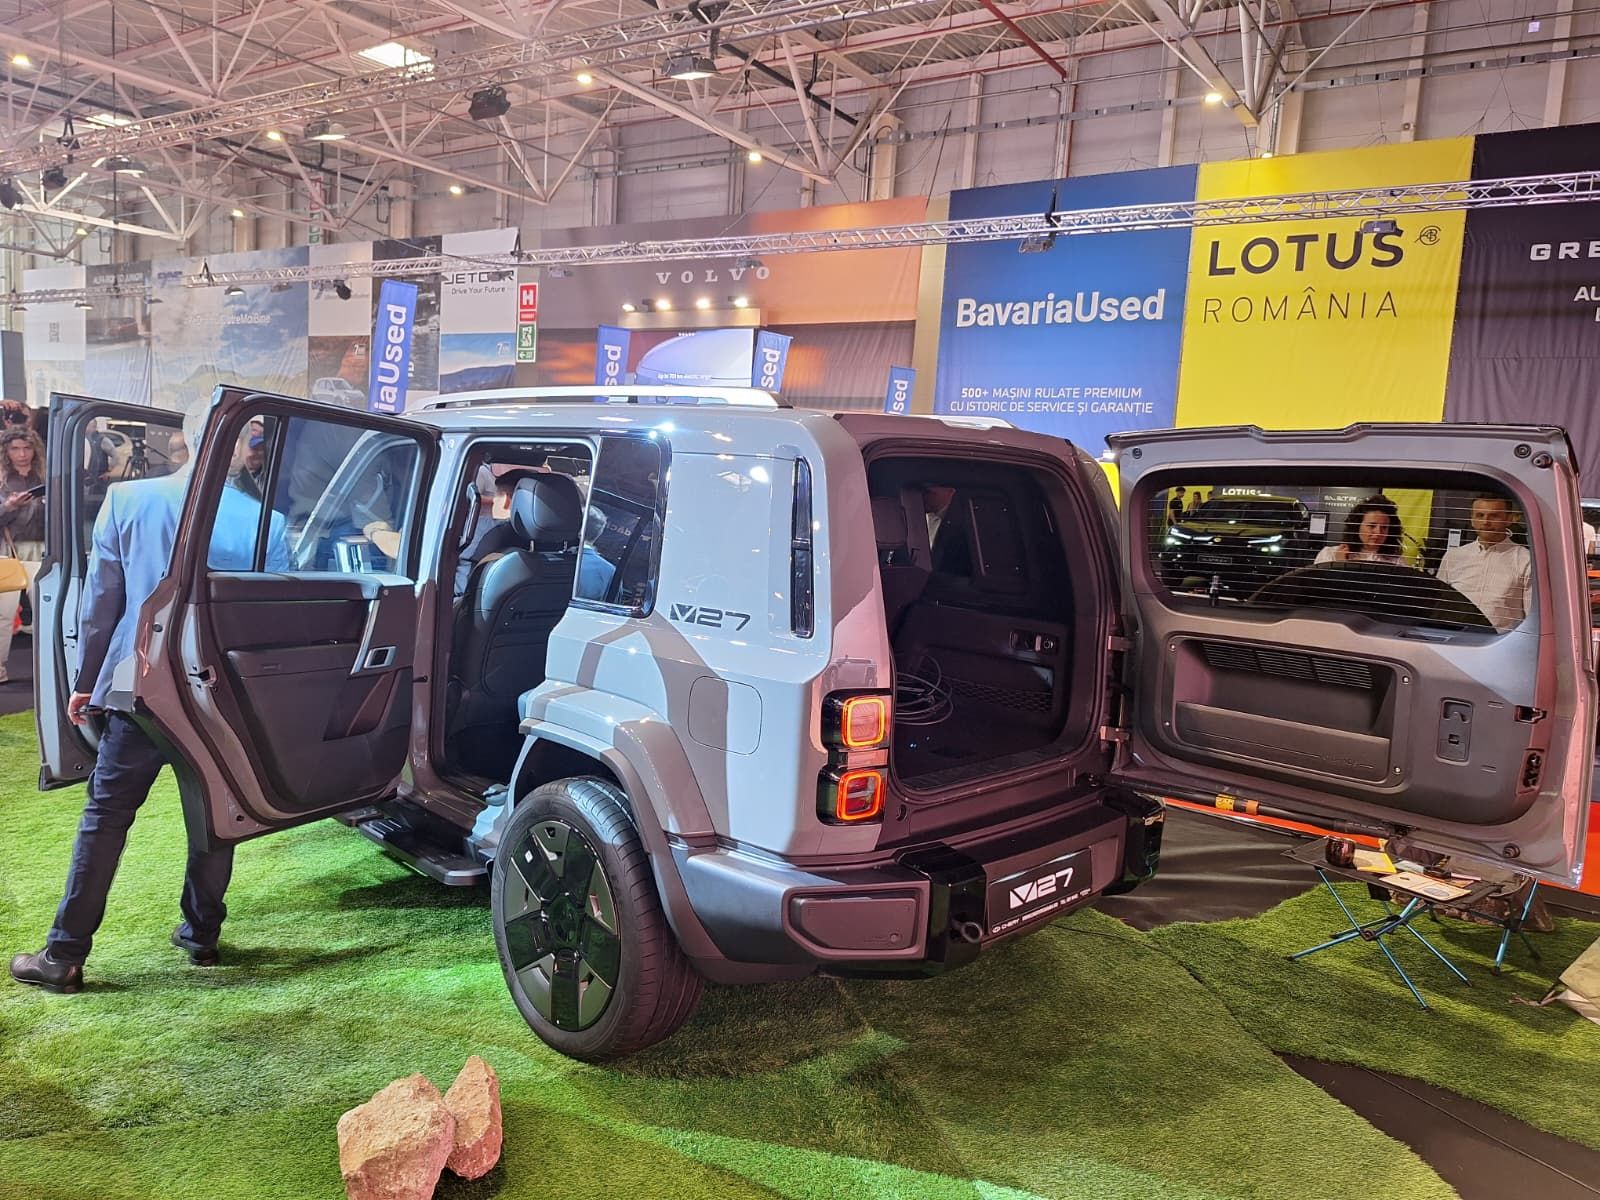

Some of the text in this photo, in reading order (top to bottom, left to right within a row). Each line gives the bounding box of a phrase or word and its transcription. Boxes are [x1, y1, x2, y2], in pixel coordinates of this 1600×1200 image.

[1207, 228, 1404, 277] LOTUS
[1530, 241, 1600, 261] GRE
[655, 266, 770, 285] VOLVO
[451, 287, 469, 295] Drive
[484, 286, 506, 294] Future
[956, 288, 1166, 328] BavariaUsed
[1203, 286, 1398, 324] ROMÂNIA
[889, 379, 909, 415] sed
[961, 388, 989, 398] 500+
[1034, 387, 1080, 399] RULATE
[1083, 387, 1142, 398] PREMIUM
[950, 402, 963, 412] CU
[966, 402, 1007, 412] ISTORIC
[1009, 402, 1025, 412] DE
[1027, 402, 1074, 413] SERVICE
